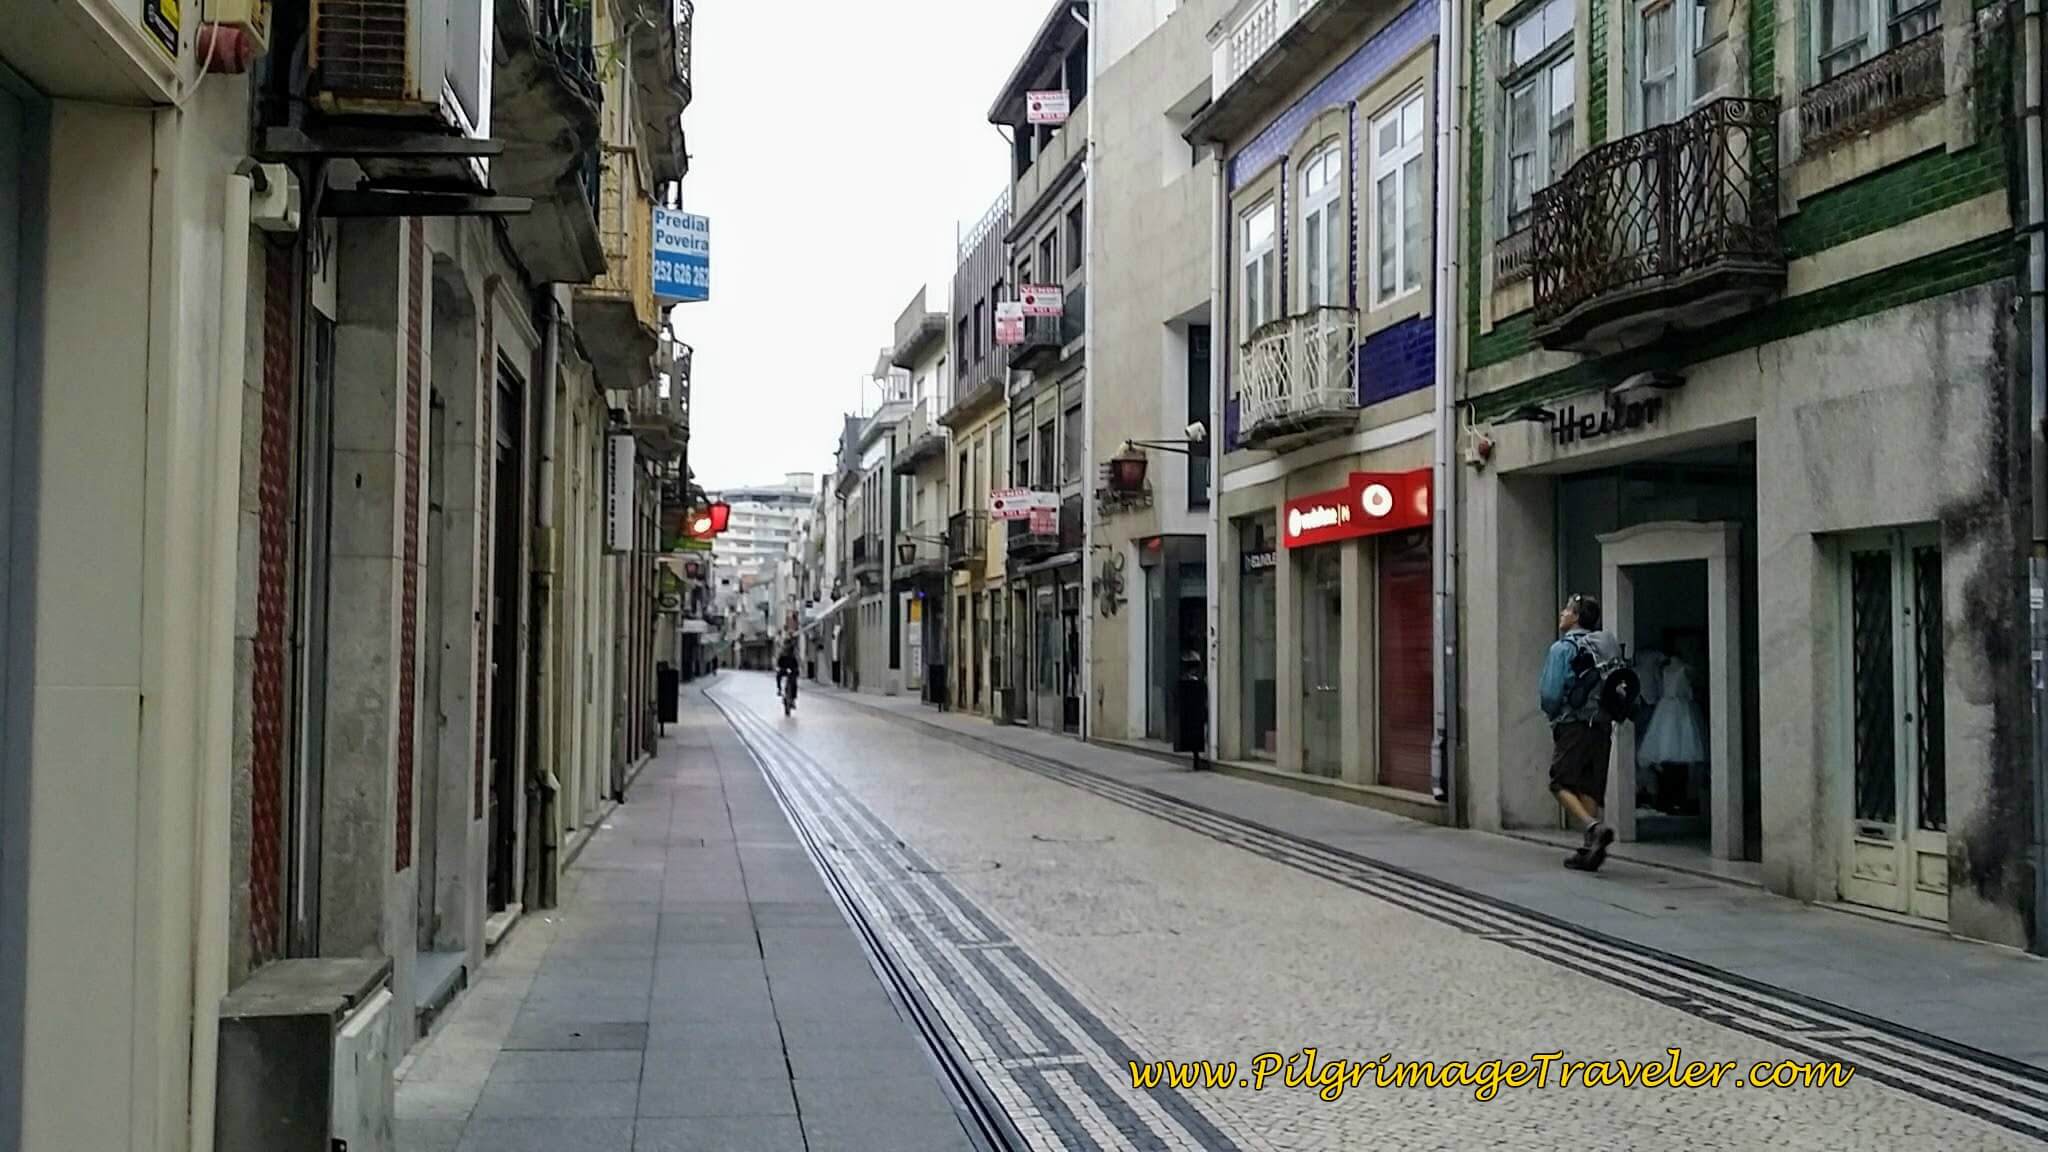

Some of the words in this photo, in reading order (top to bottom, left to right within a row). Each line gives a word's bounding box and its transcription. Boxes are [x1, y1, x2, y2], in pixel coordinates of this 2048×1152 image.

[655, 210, 709, 233] Predial
[655, 229, 709, 250] Poveira
[654, 259, 673, 282] 252
[673, 262, 692, 286] 626
[1551, 388, 1663, 445] Heitor
